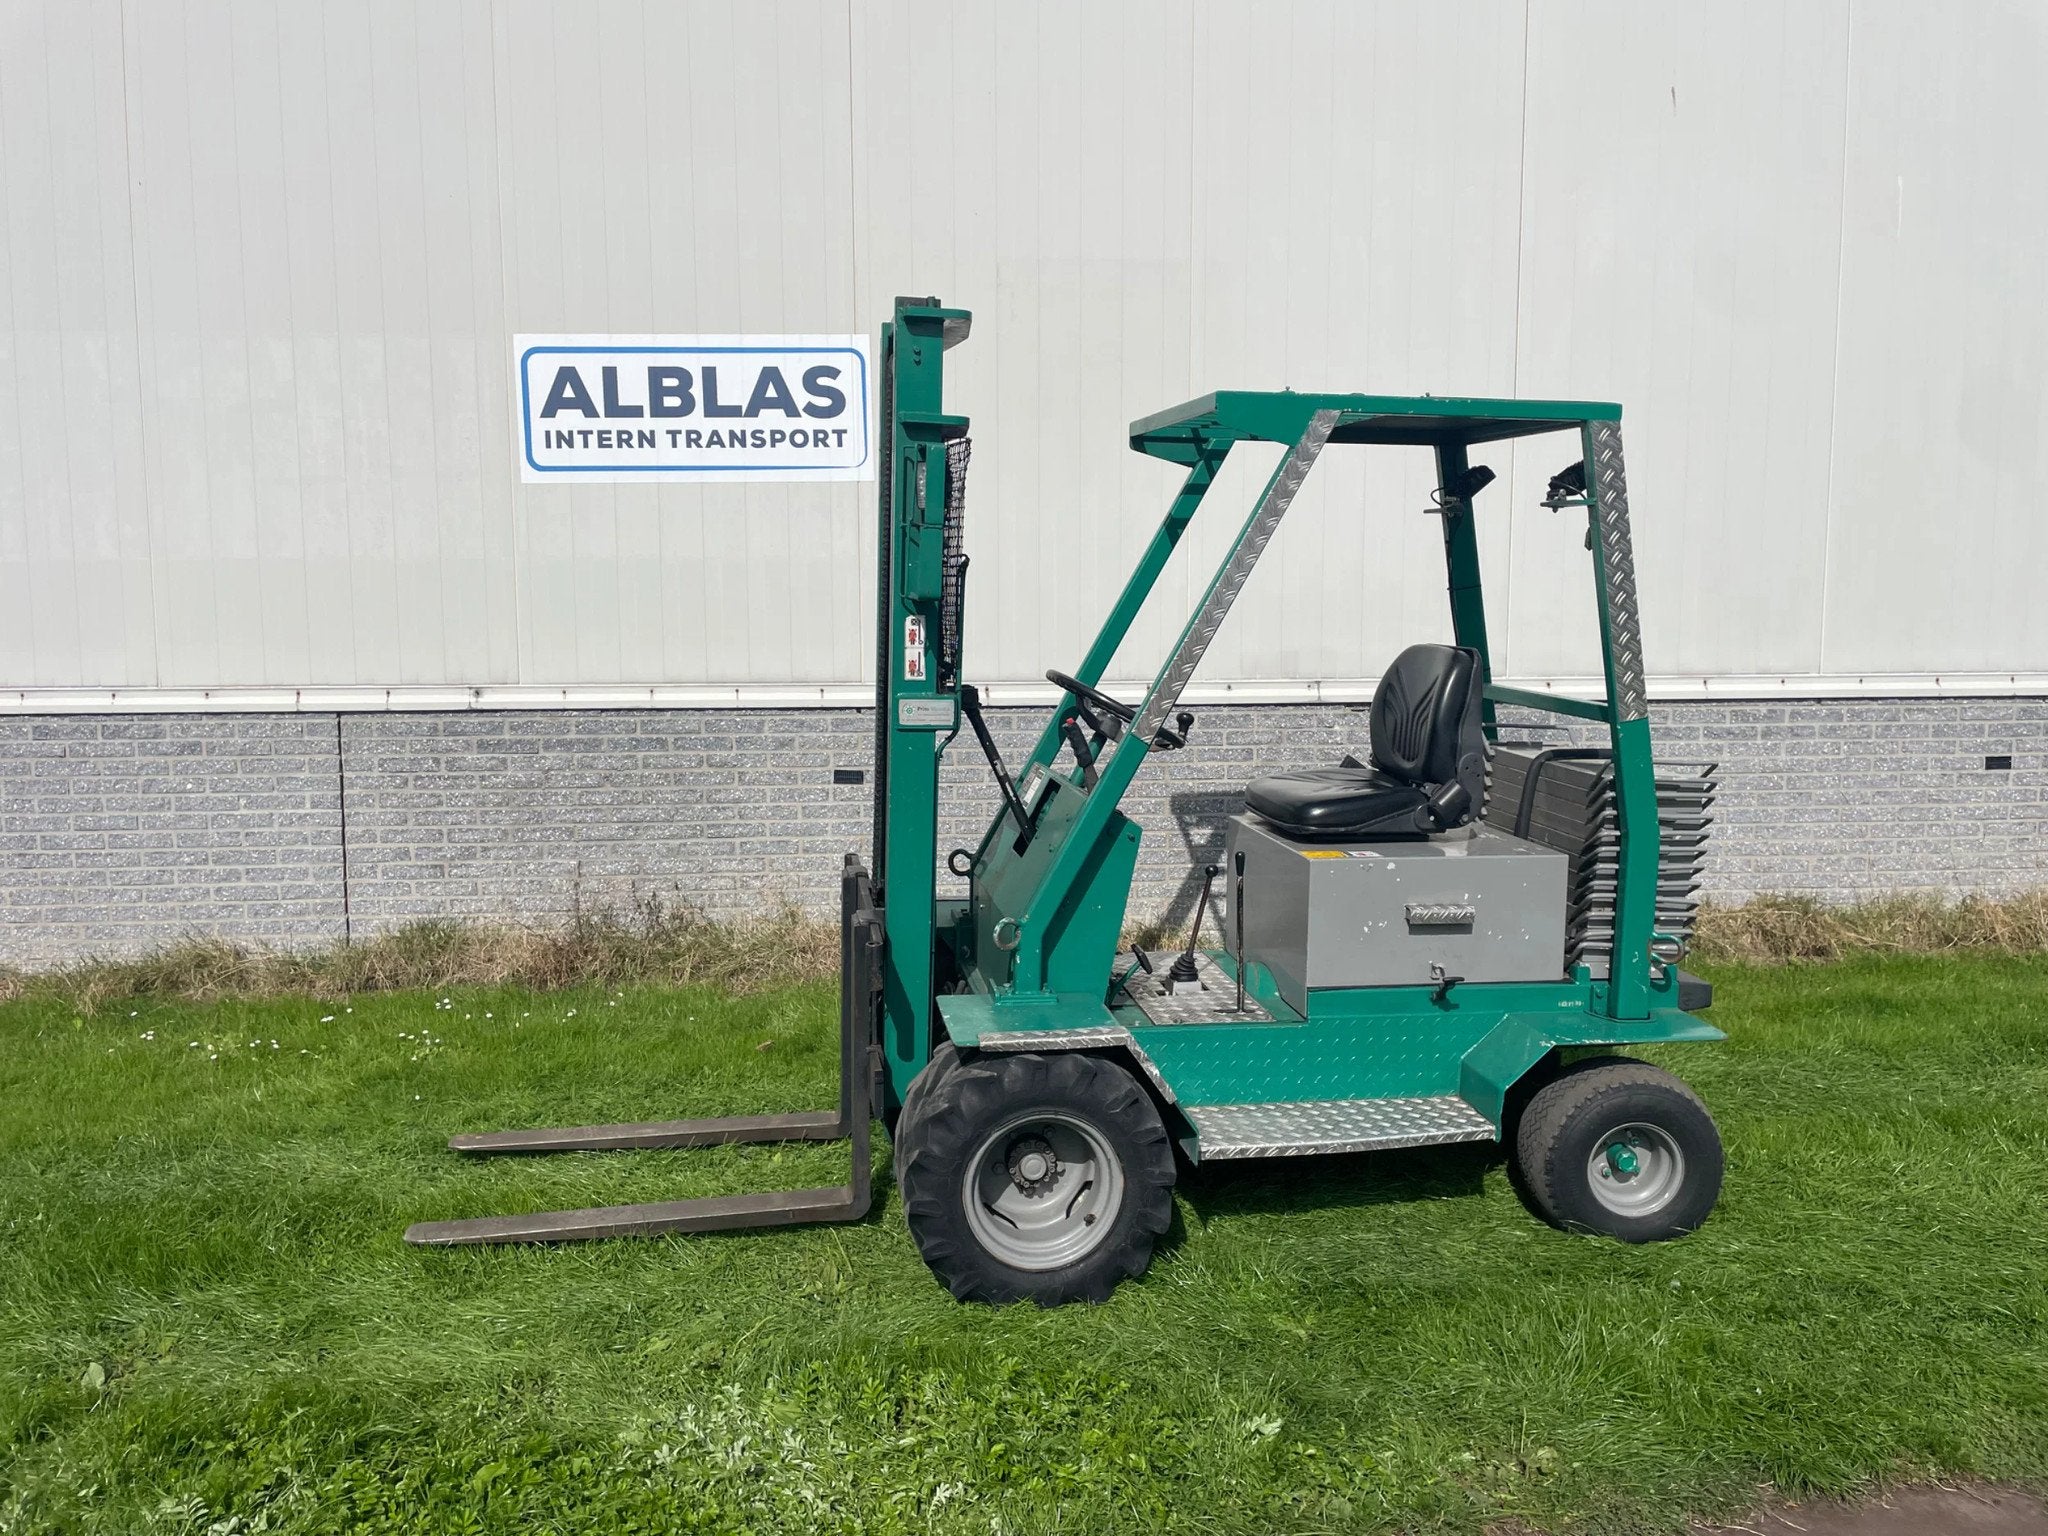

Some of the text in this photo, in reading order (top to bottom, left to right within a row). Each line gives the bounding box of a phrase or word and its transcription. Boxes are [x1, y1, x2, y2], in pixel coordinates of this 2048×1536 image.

[540, 365, 847, 419] ALBLAS
[544, 428, 848, 449] INTERN TRANSPORT
